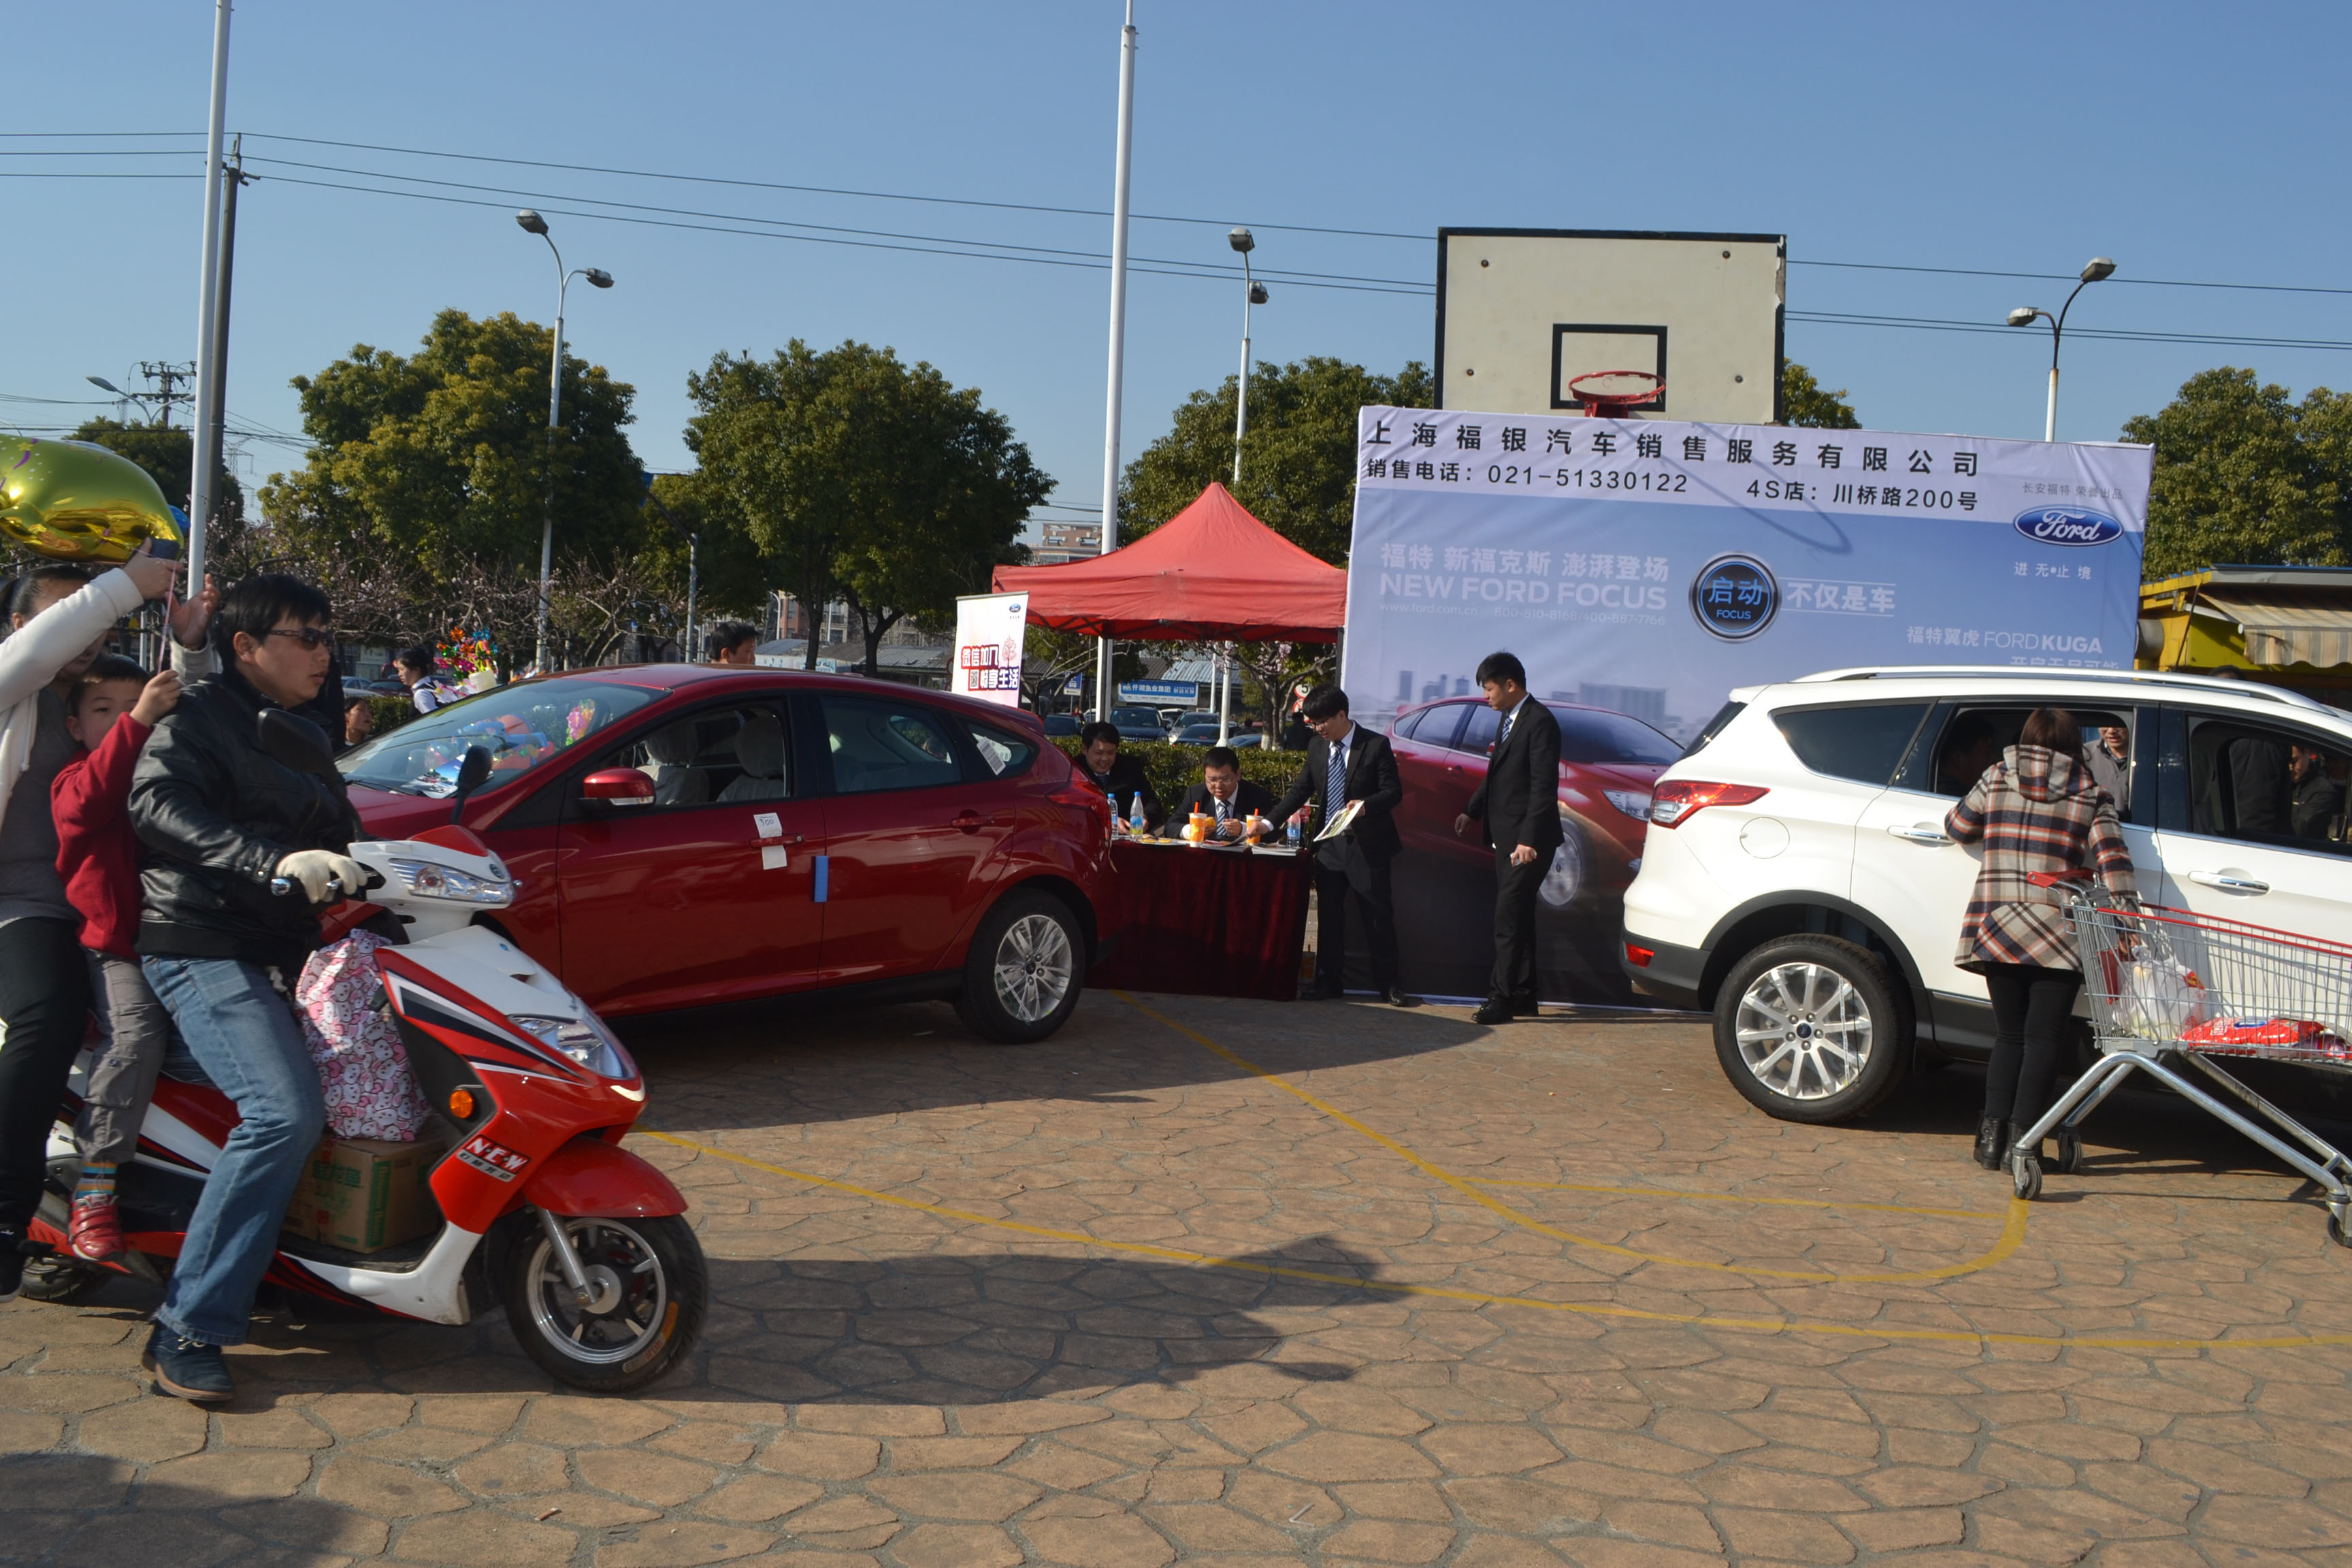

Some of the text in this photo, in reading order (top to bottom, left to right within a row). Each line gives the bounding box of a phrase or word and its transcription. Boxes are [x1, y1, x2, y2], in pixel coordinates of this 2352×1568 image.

[1367, 421, 1978, 476] 上海福银汽车销售服务有限公司
[2022, 482, 2070, 496] 长安福特
[2035, 510, 2102, 540] Ford
[1380, 542, 1669, 583] 福特 新福克斯 澎湃登场
[1379, 573, 1667, 610] NEW FORD FOCUS
[1708, 575, 1763, 606] 启动
[1786, 582, 1895, 612] 不仅是车
[1379, 602, 1478, 616] www.ford.com.cn
[1716, 610, 1752, 620] FOCUS
[1907, 626, 2104, 654] 福特翼虎 FORD KUGA
